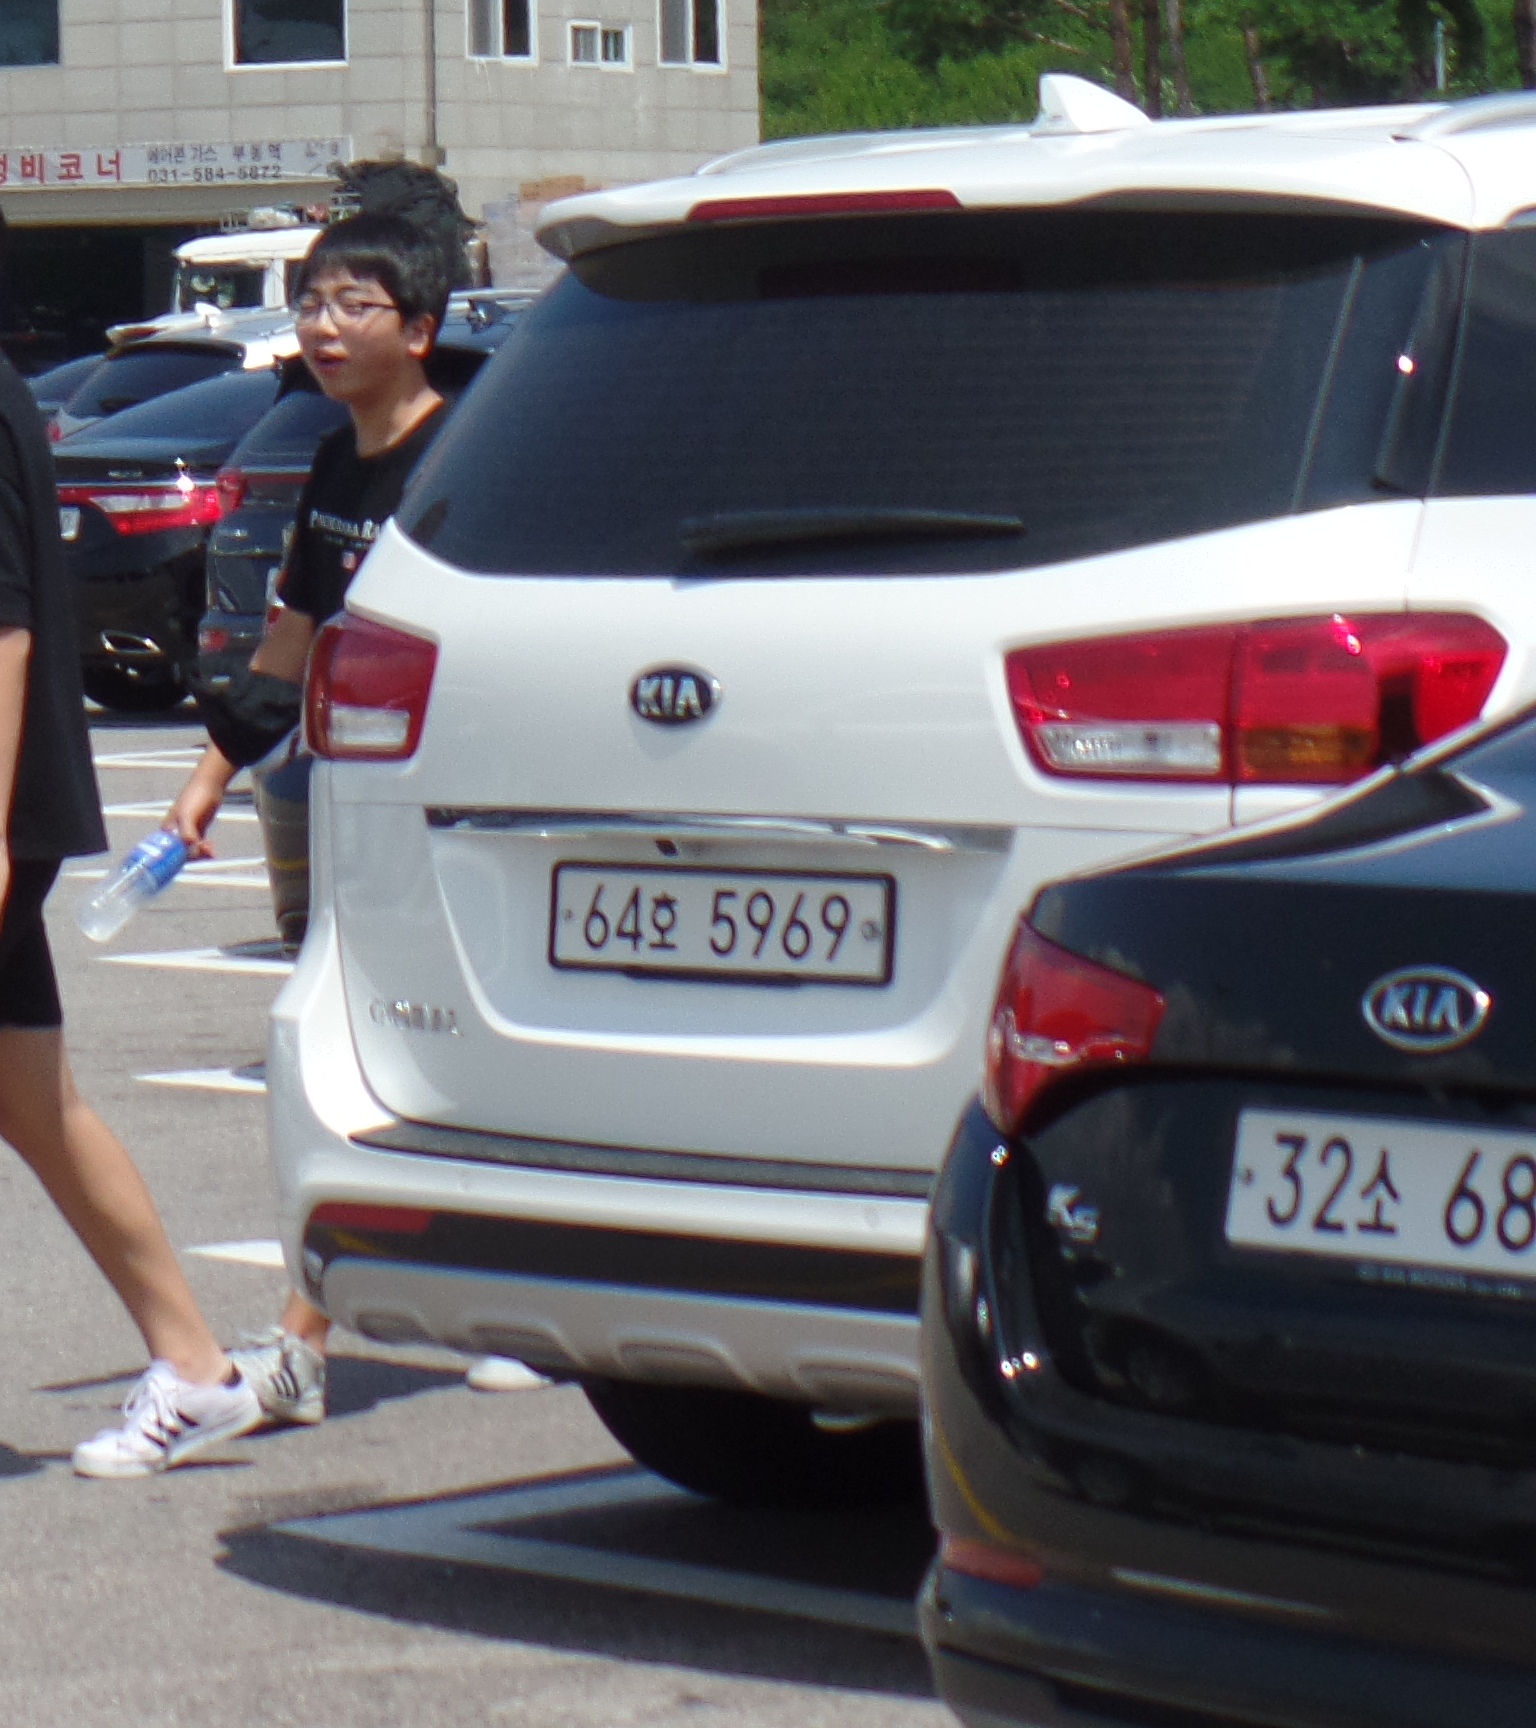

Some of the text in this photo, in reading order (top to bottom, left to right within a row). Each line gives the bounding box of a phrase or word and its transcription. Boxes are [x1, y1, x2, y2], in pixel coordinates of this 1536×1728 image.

[637, 676, 705, 720] KIA
[583, 883, 852, 961] 64호 5969
[1379, 982, 1465, 1035] KIA
[1266, 1132, 1402, 1236] 32소
